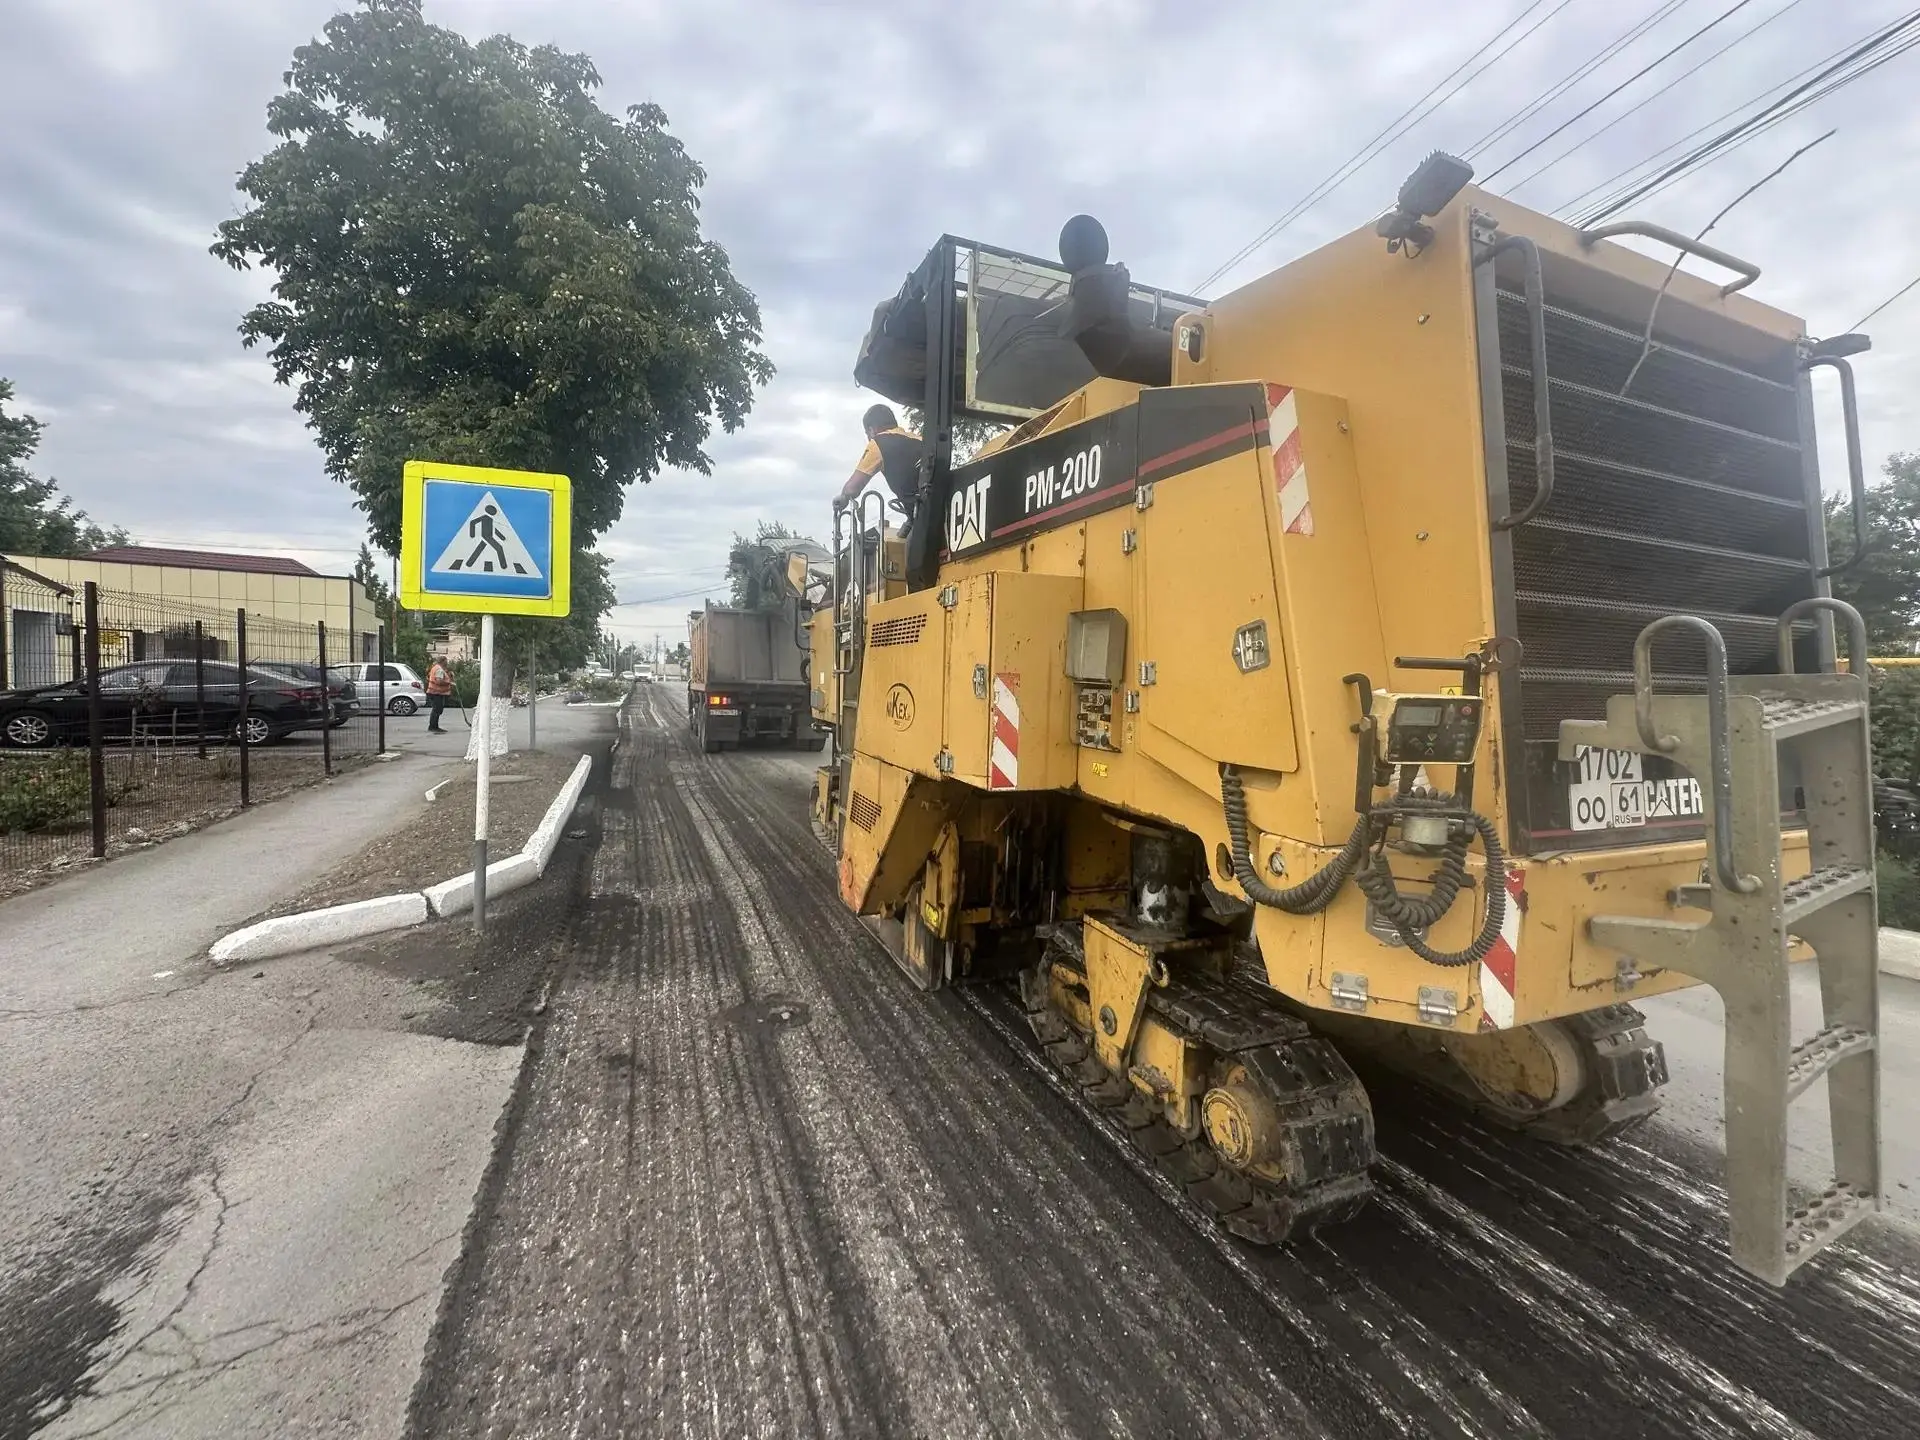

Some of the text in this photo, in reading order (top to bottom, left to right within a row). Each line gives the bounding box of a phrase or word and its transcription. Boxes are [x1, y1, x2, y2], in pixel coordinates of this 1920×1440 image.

[949, 444, 1102, 552] CAT PM-200
[1577, 747, 1634, 781] 1702
[1618, 786, 1640, 812] 61
[1614, 814, 1632, 825] RUS
